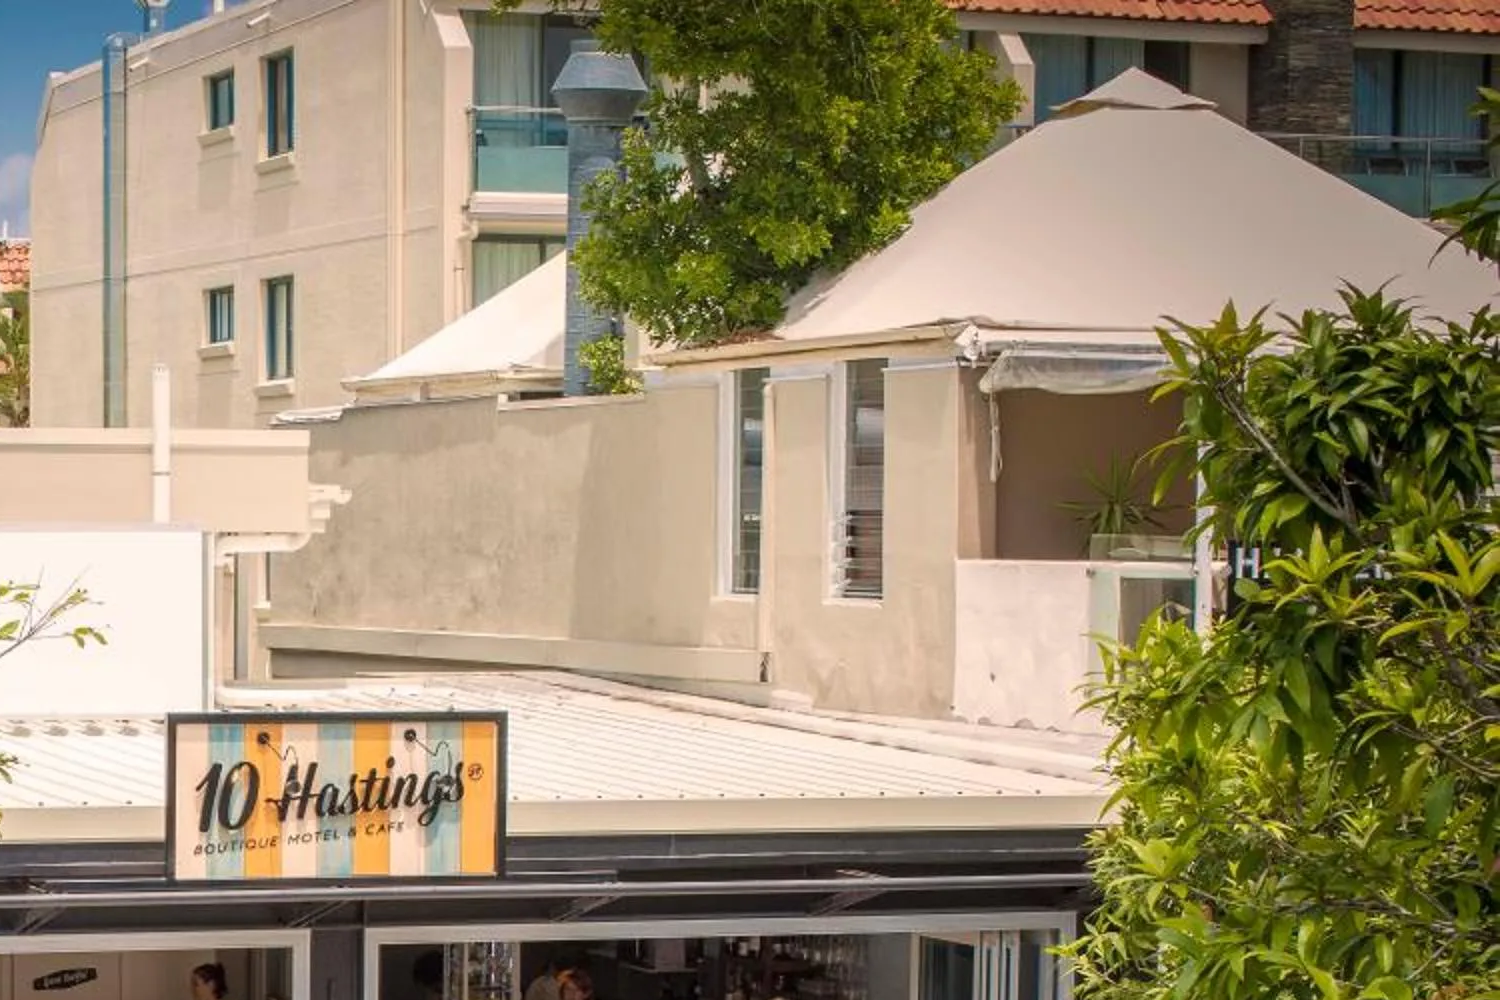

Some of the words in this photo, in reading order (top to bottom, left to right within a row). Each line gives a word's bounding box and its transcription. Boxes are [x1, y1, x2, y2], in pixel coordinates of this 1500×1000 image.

[196, 761, 260, 832] 10
[265, 756, 464, 827] Hastings
[193, 836, 280, 856] BOUTIQUE
[287, 829, 341, 846] MOTEL
